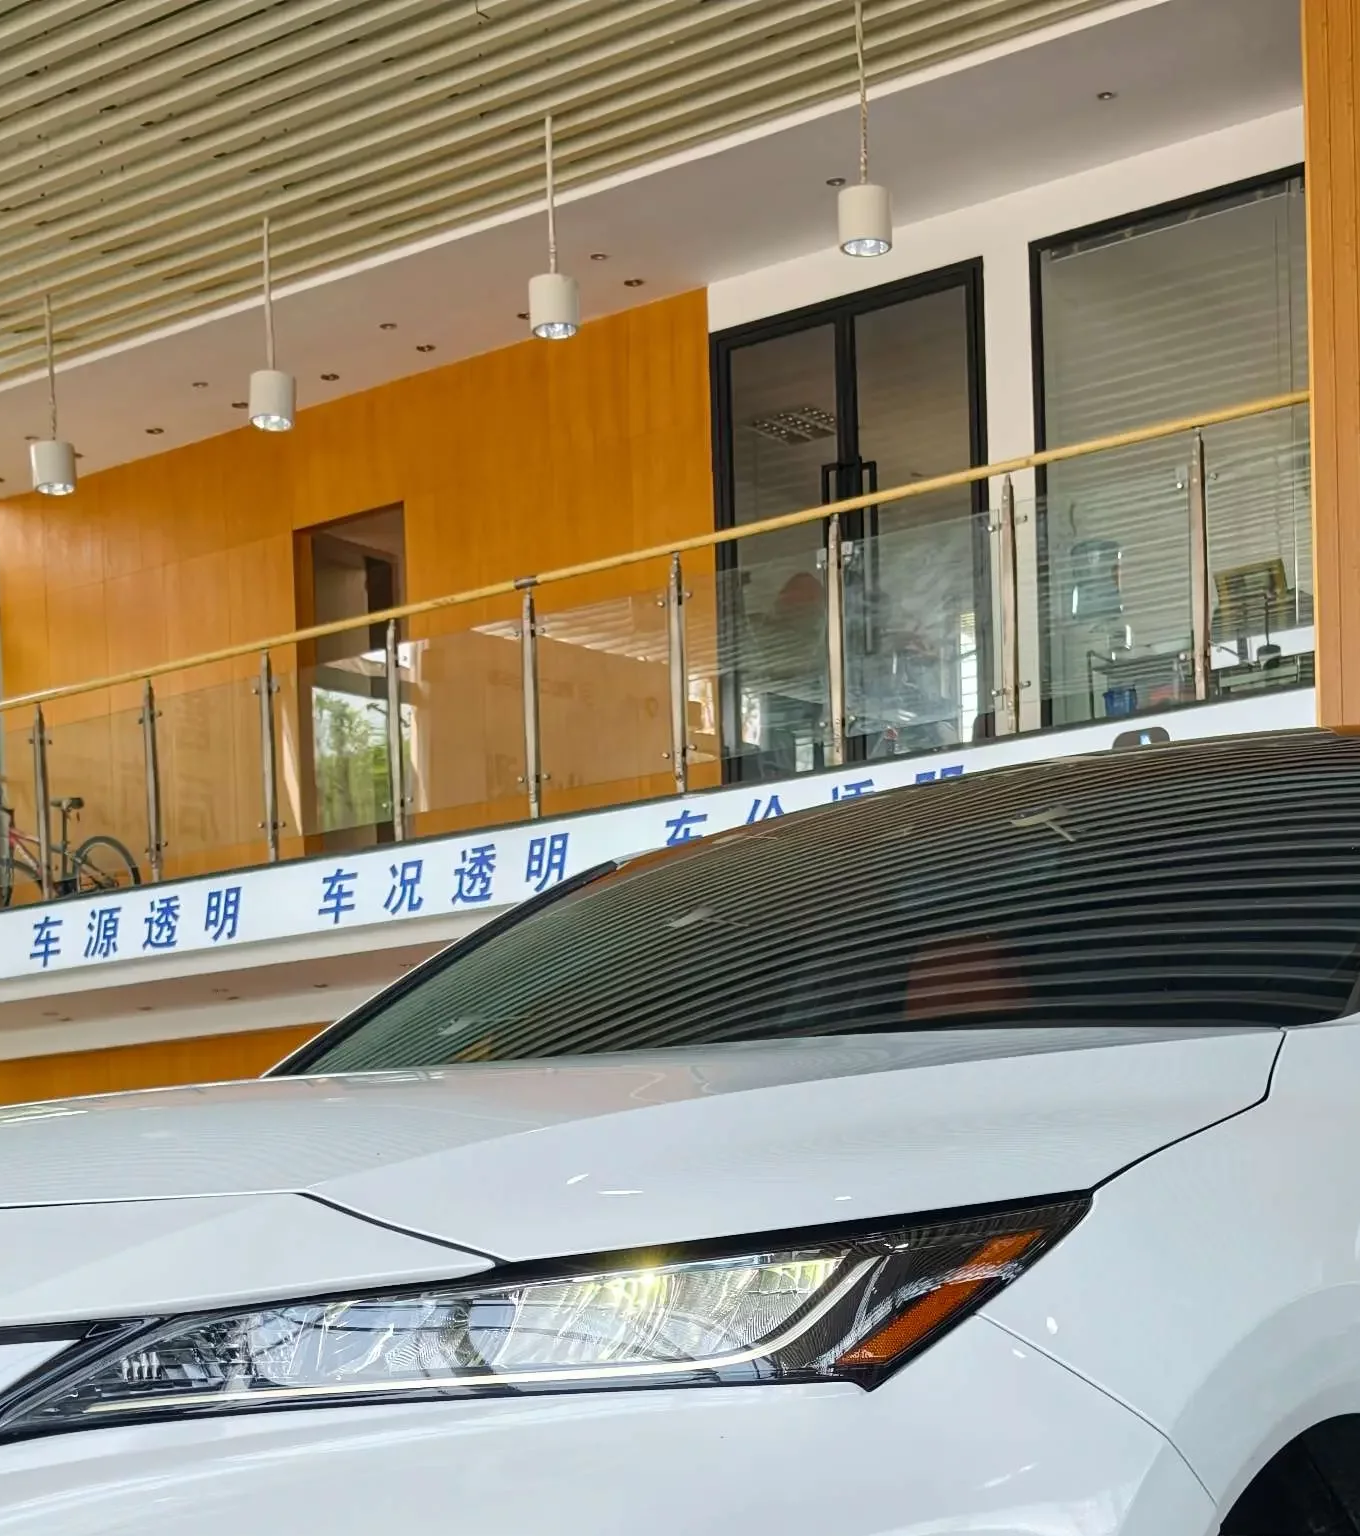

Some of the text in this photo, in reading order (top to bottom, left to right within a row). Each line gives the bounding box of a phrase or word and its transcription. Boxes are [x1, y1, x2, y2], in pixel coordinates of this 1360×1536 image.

[29, 886, 242, 968] 车源透明
[318, 832, 570, 925] 车况透明
